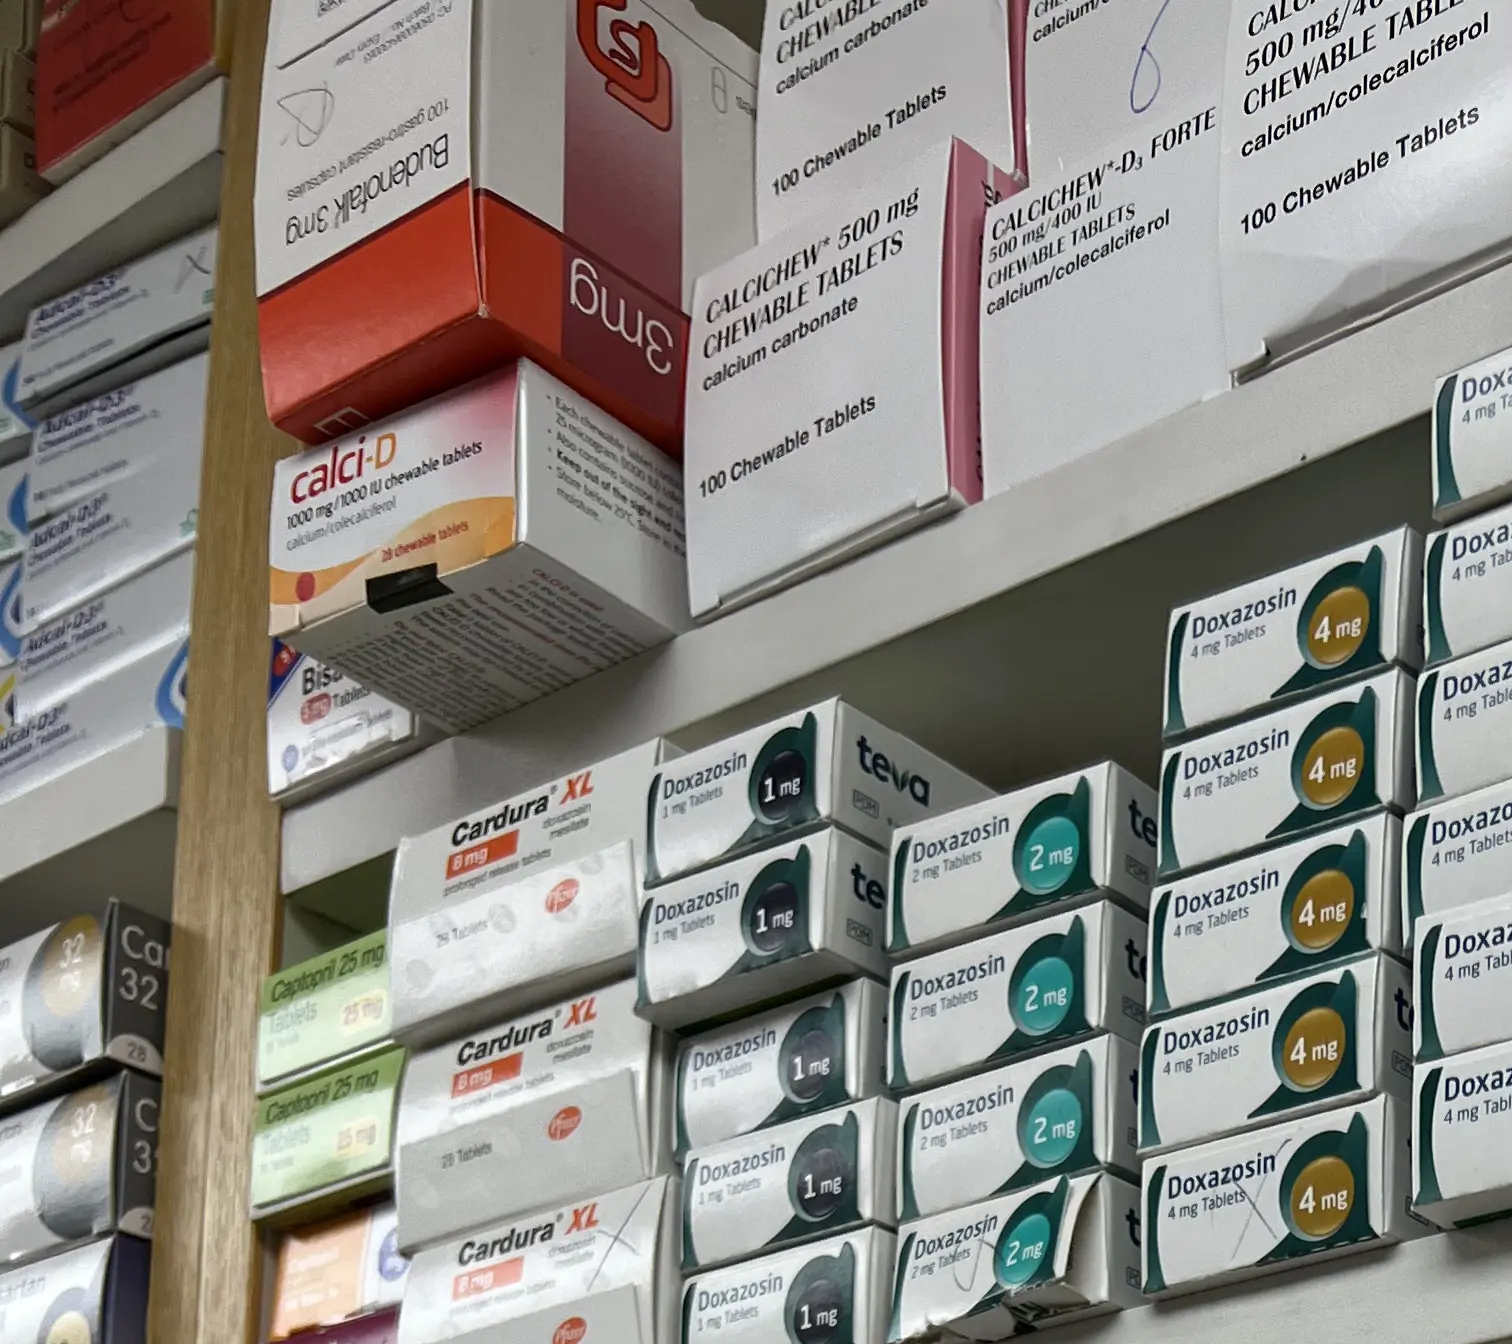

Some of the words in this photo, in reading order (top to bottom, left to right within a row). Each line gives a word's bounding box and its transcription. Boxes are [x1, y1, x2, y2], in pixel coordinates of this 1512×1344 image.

[1240, 12, 1490, 158] calcium/colecalciferol
[335, 134, 449, 230] Budenofalk
[1240, 201, 1276, 235] 100
[1282, 150, 1390, 214] Chewable
[1395, 104, 1481, 160] Tablets
[286, 207, 329, 245] 3mg
[838, 213, 882, 253] 500
[886, 188, 920, 228] mg
[570, 258, 674, 375] 3mg
[703, 284, 809, 361] CHEWABLE
[815, 230, 904, 297] TABLETS
[290, 432, 397, 504] calci-D
[699, 469, 727, 498] 100
[730, 426, 810, 483] Chewable
[813, 395, 877, 438] Tablets
[1190, 645, 1198, 658] 4
[1201, 637, 1221, 657] mg
[1224, 623, 1266, 649] Tablets
[1192, 587, 1297, 640] Doxazosin
[1314, 619, 1332, 642] 4
[1335, 617, 1362, 639] mg
[559, 770, 594, 804] XL
[663, 752, 747, 800] Doxazosin
[856, 735, 930, 808] teva
[912, 813, 1009, 864] Doxazosin
[1029, 845, 1044, 872] 2
[1049, 843, 1073, 866] mg
